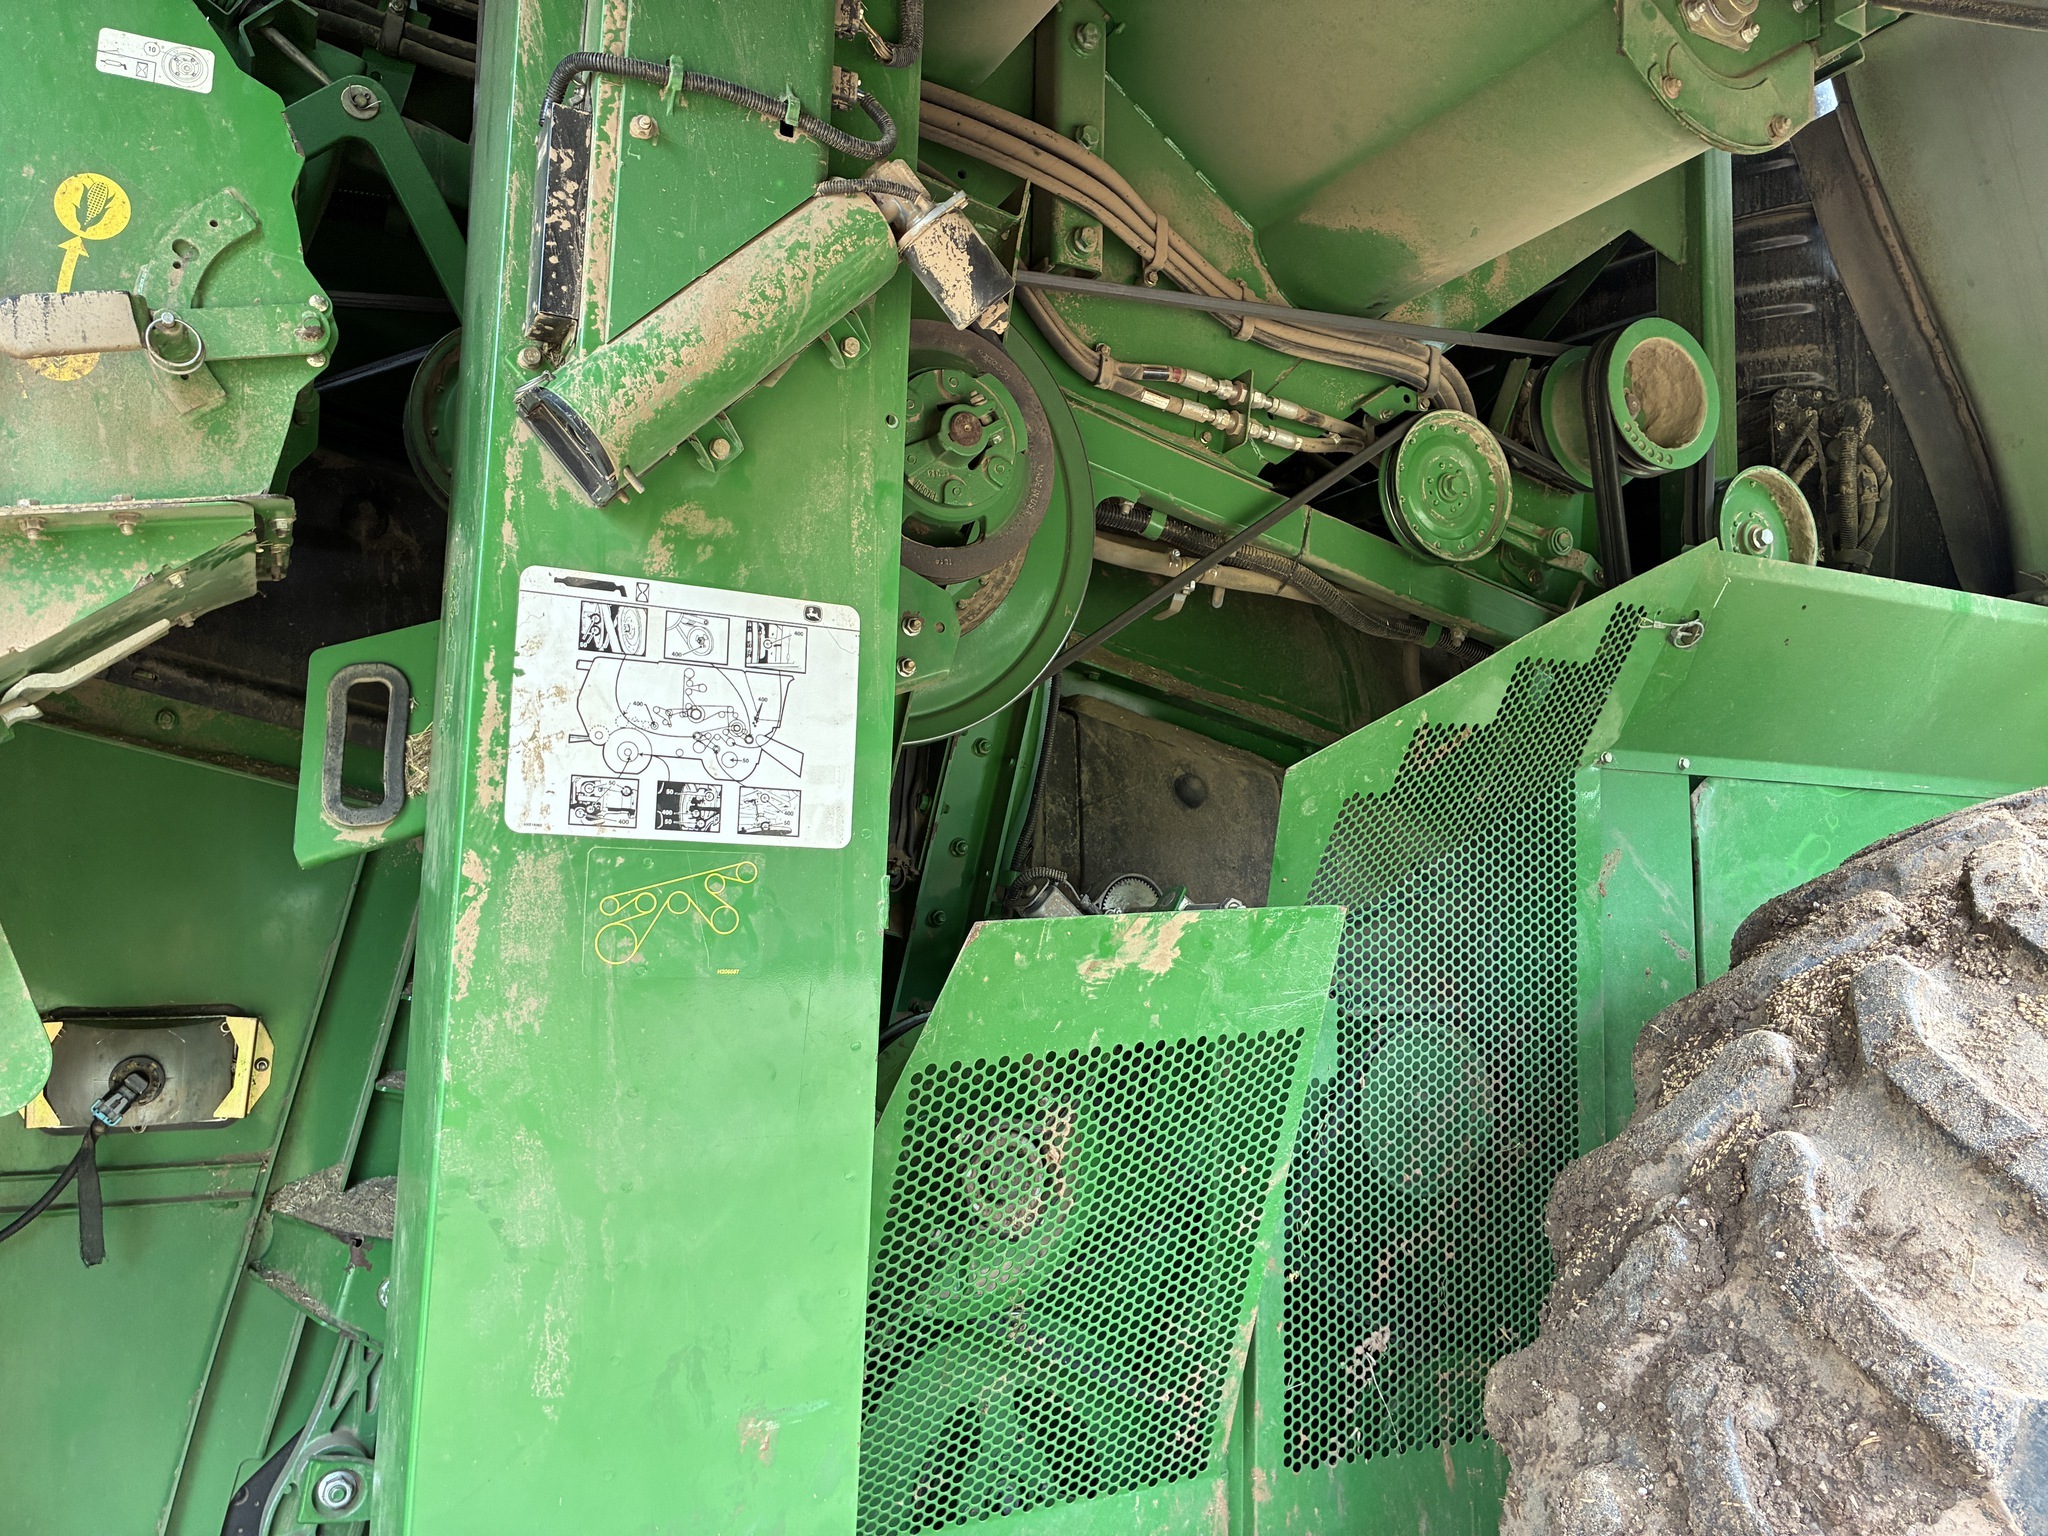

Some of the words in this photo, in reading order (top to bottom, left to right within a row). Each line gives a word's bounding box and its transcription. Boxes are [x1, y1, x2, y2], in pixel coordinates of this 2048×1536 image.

[1034, 464, 1044, 489] MADE
[1032, 489, 1041, 498] IN
[1025, 498, 1038, 516] USA
